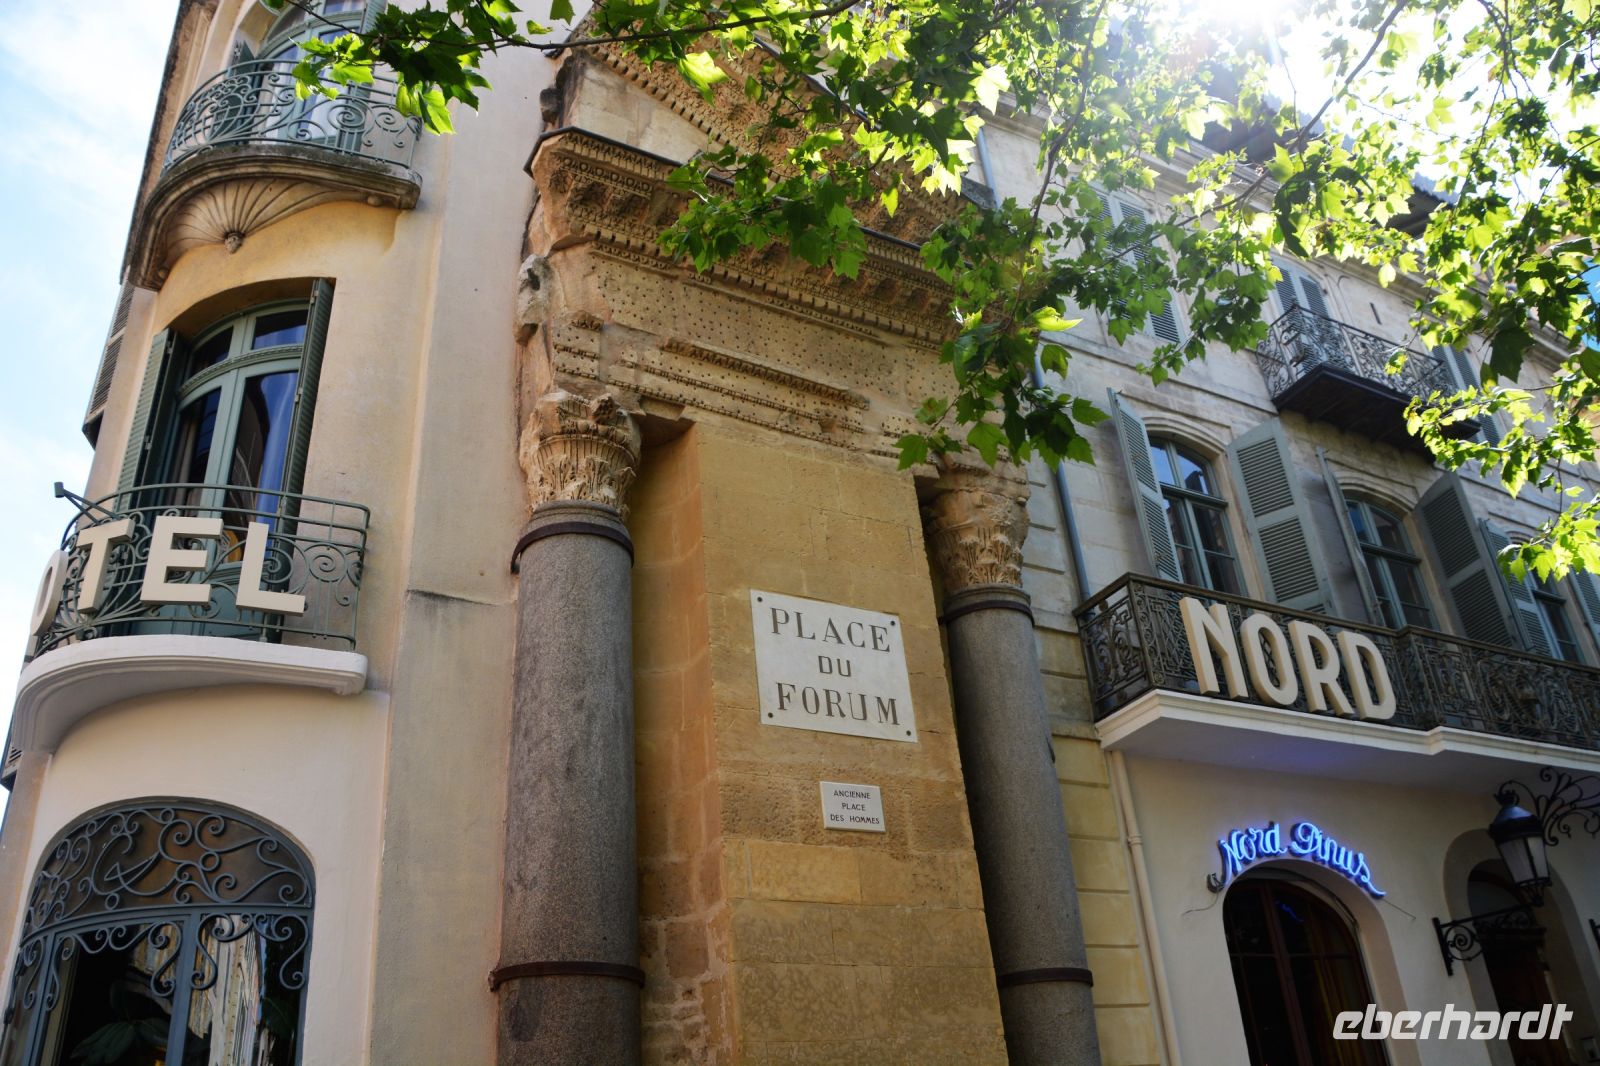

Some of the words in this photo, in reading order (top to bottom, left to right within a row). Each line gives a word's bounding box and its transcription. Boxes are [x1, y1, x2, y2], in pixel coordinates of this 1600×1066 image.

[31, 515, 306, 636] OTEL
[770, 607, 891, 652] PLACE
[818, 655, 852, 677] DU
[1179, 597, 1397, 721] NORD
[776, 682, 900, 725] FORUM
[833, 789, 871, 799] ANCIENNE
[841, 802, 866, 811] PLACE
[830, 814, 845, 822] DES
[849, 815, 880, 824] HOMMES
[1208, 822, 1288, 891] Nord
[1290, 821, 1387, 897] Pinus
